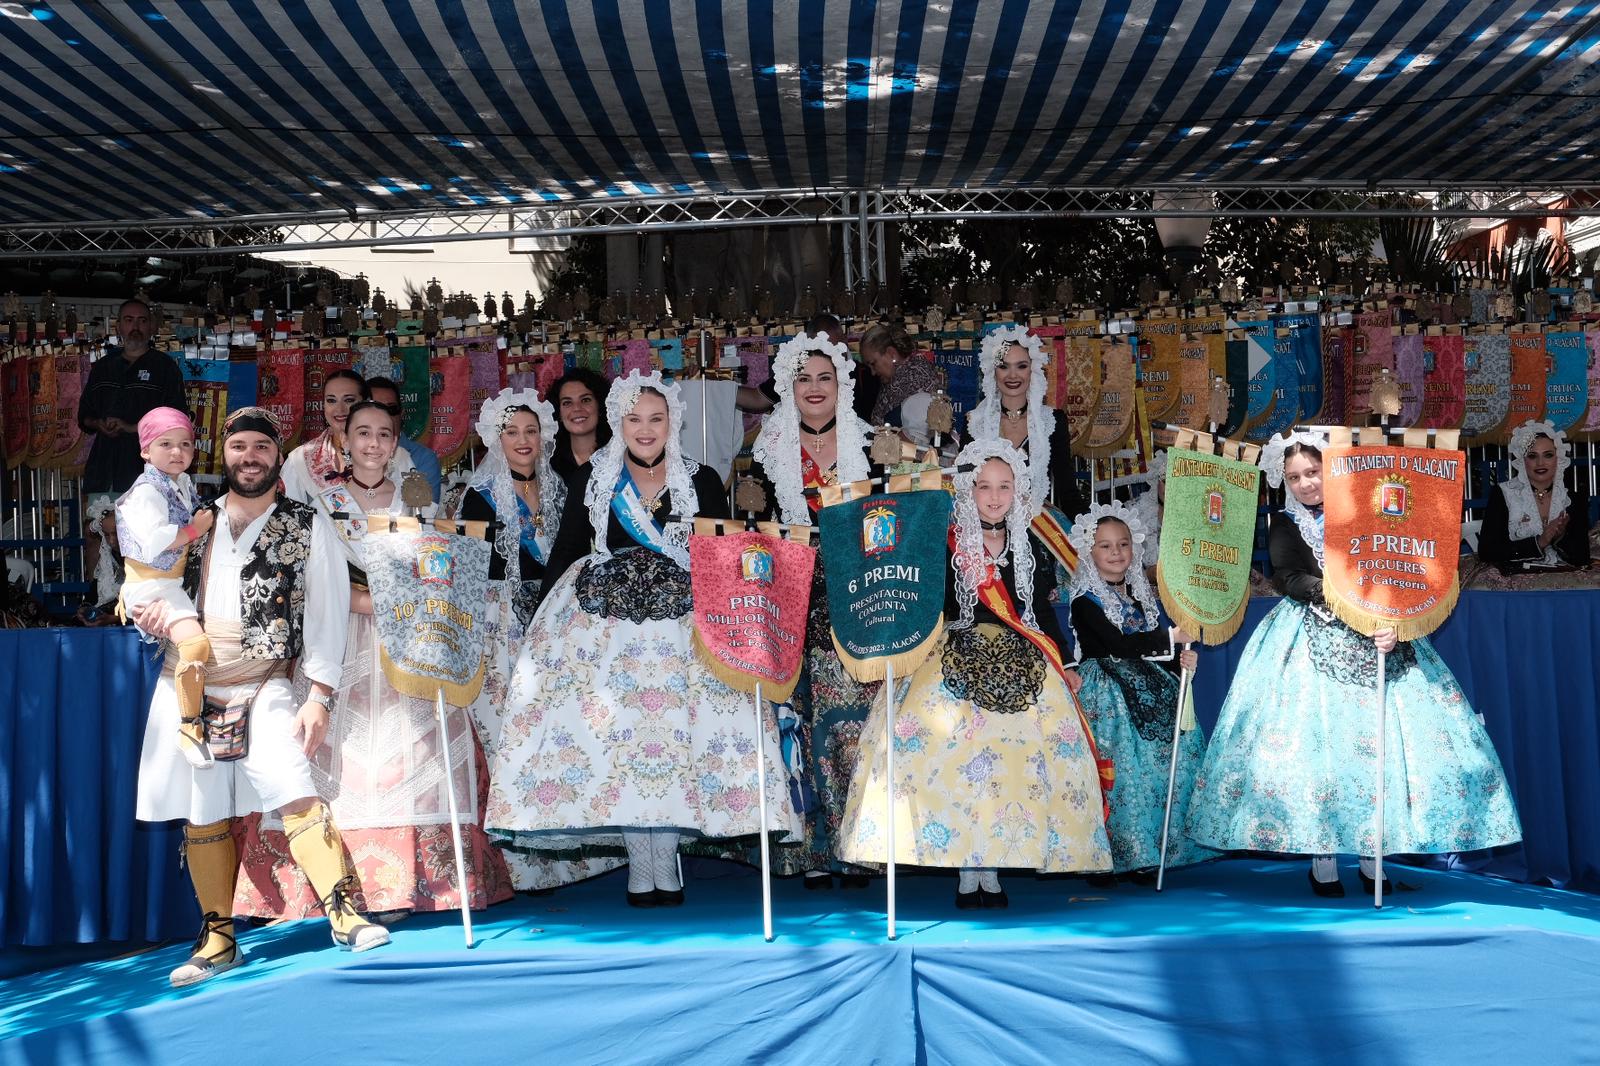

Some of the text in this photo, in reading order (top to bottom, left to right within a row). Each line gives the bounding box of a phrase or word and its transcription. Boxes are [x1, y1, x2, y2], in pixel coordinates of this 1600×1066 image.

[1141, 370, 1169, 382] REMI
[1511, 383, 1532, 392] EMI
[399, 392, 419, 403] EMI
[271, 403, 292, 415] EMI
[431, 406, 455, 414] LOR
[432, 428, 454, 437] TER
[1330, 455, 1396, 477] AJUNTAMENT
[1199, 540, 1240, 566] PREMI
[1372, 533, 1438, 559] PREMI
[863, 564, 921, 588] PREMI
[1357, 558, 1428, 576] FOGUERES
[425, 598, 474, 631] PREMI
[730, 595, 781, 621] PREMI
[858, 600, 907, 620] CONJUNTA
[1405, 596, 1437, 616] ALACANT
[706, 612, 766, 626] MILLOR
[865, 614, 896, 628] Cultural
[728, 639, 744, 648] de
[891, 630, 922, 651] ALACANT
